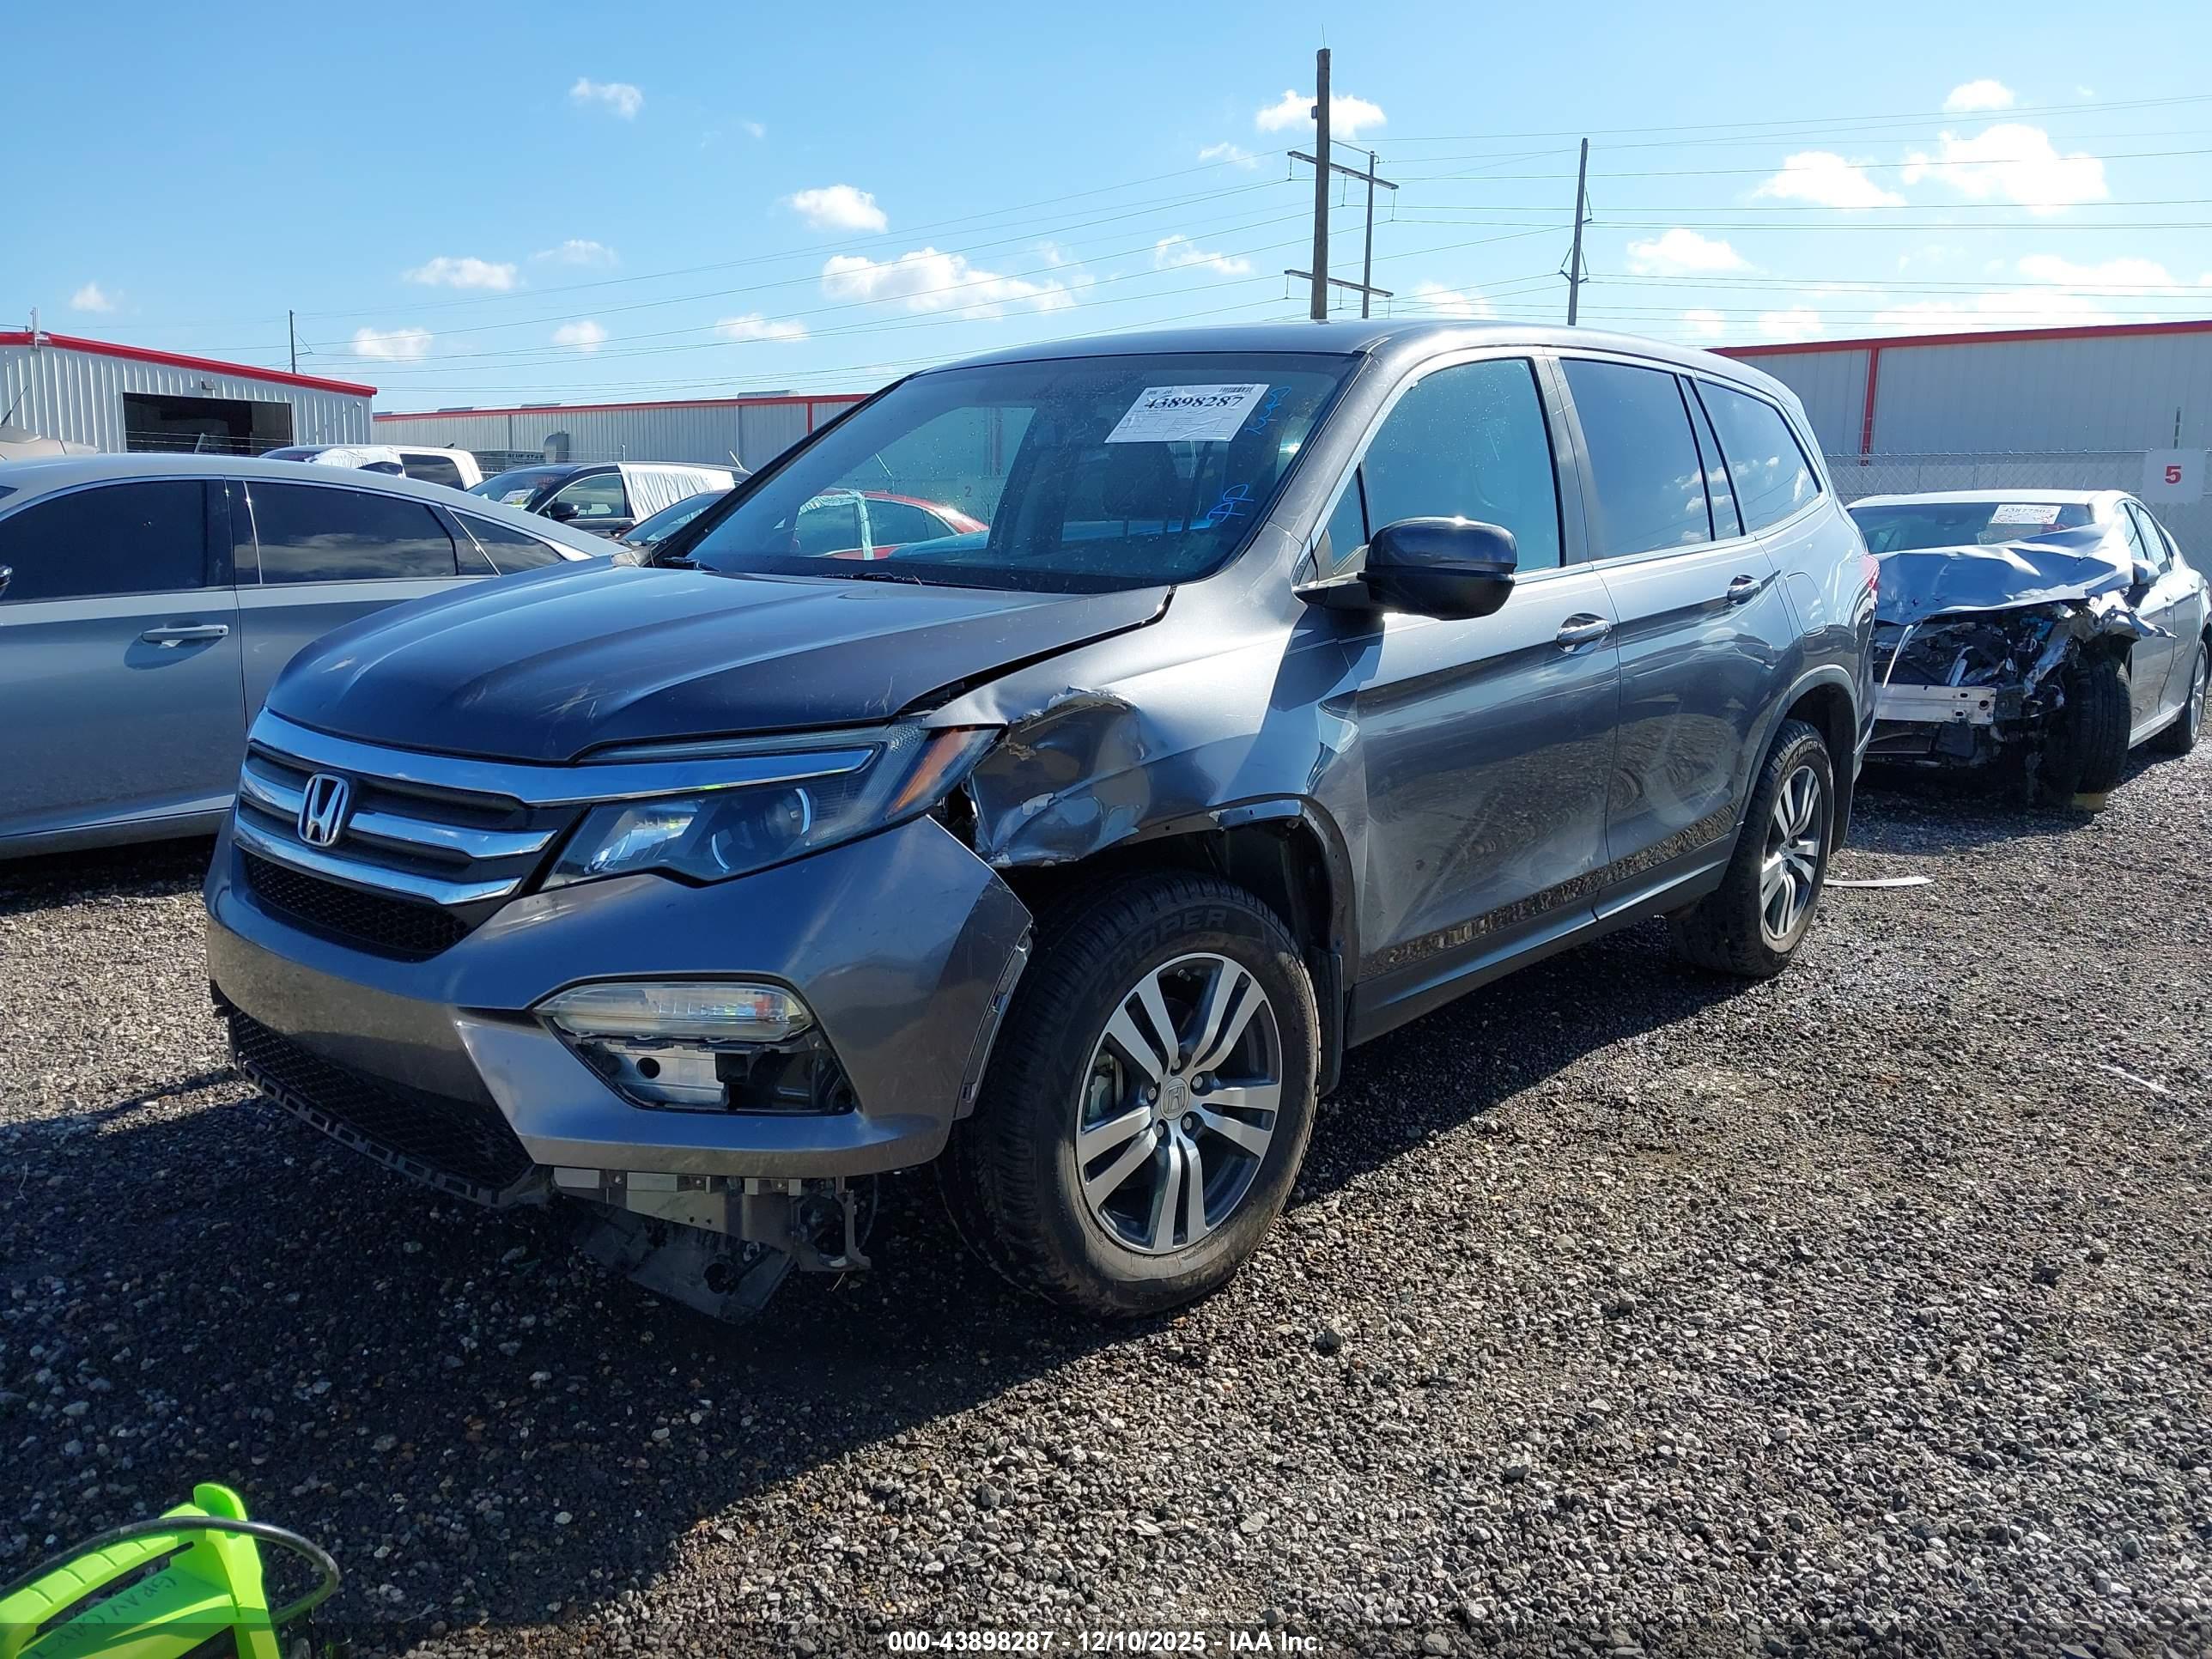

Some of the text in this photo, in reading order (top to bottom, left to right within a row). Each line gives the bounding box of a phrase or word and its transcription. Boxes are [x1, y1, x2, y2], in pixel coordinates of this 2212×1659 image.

[1144, 397, 1245, 409] 43898287
[2165, 465, 2182, 484] 5
[1780, 741, 1819, 785] NDEAVOR
